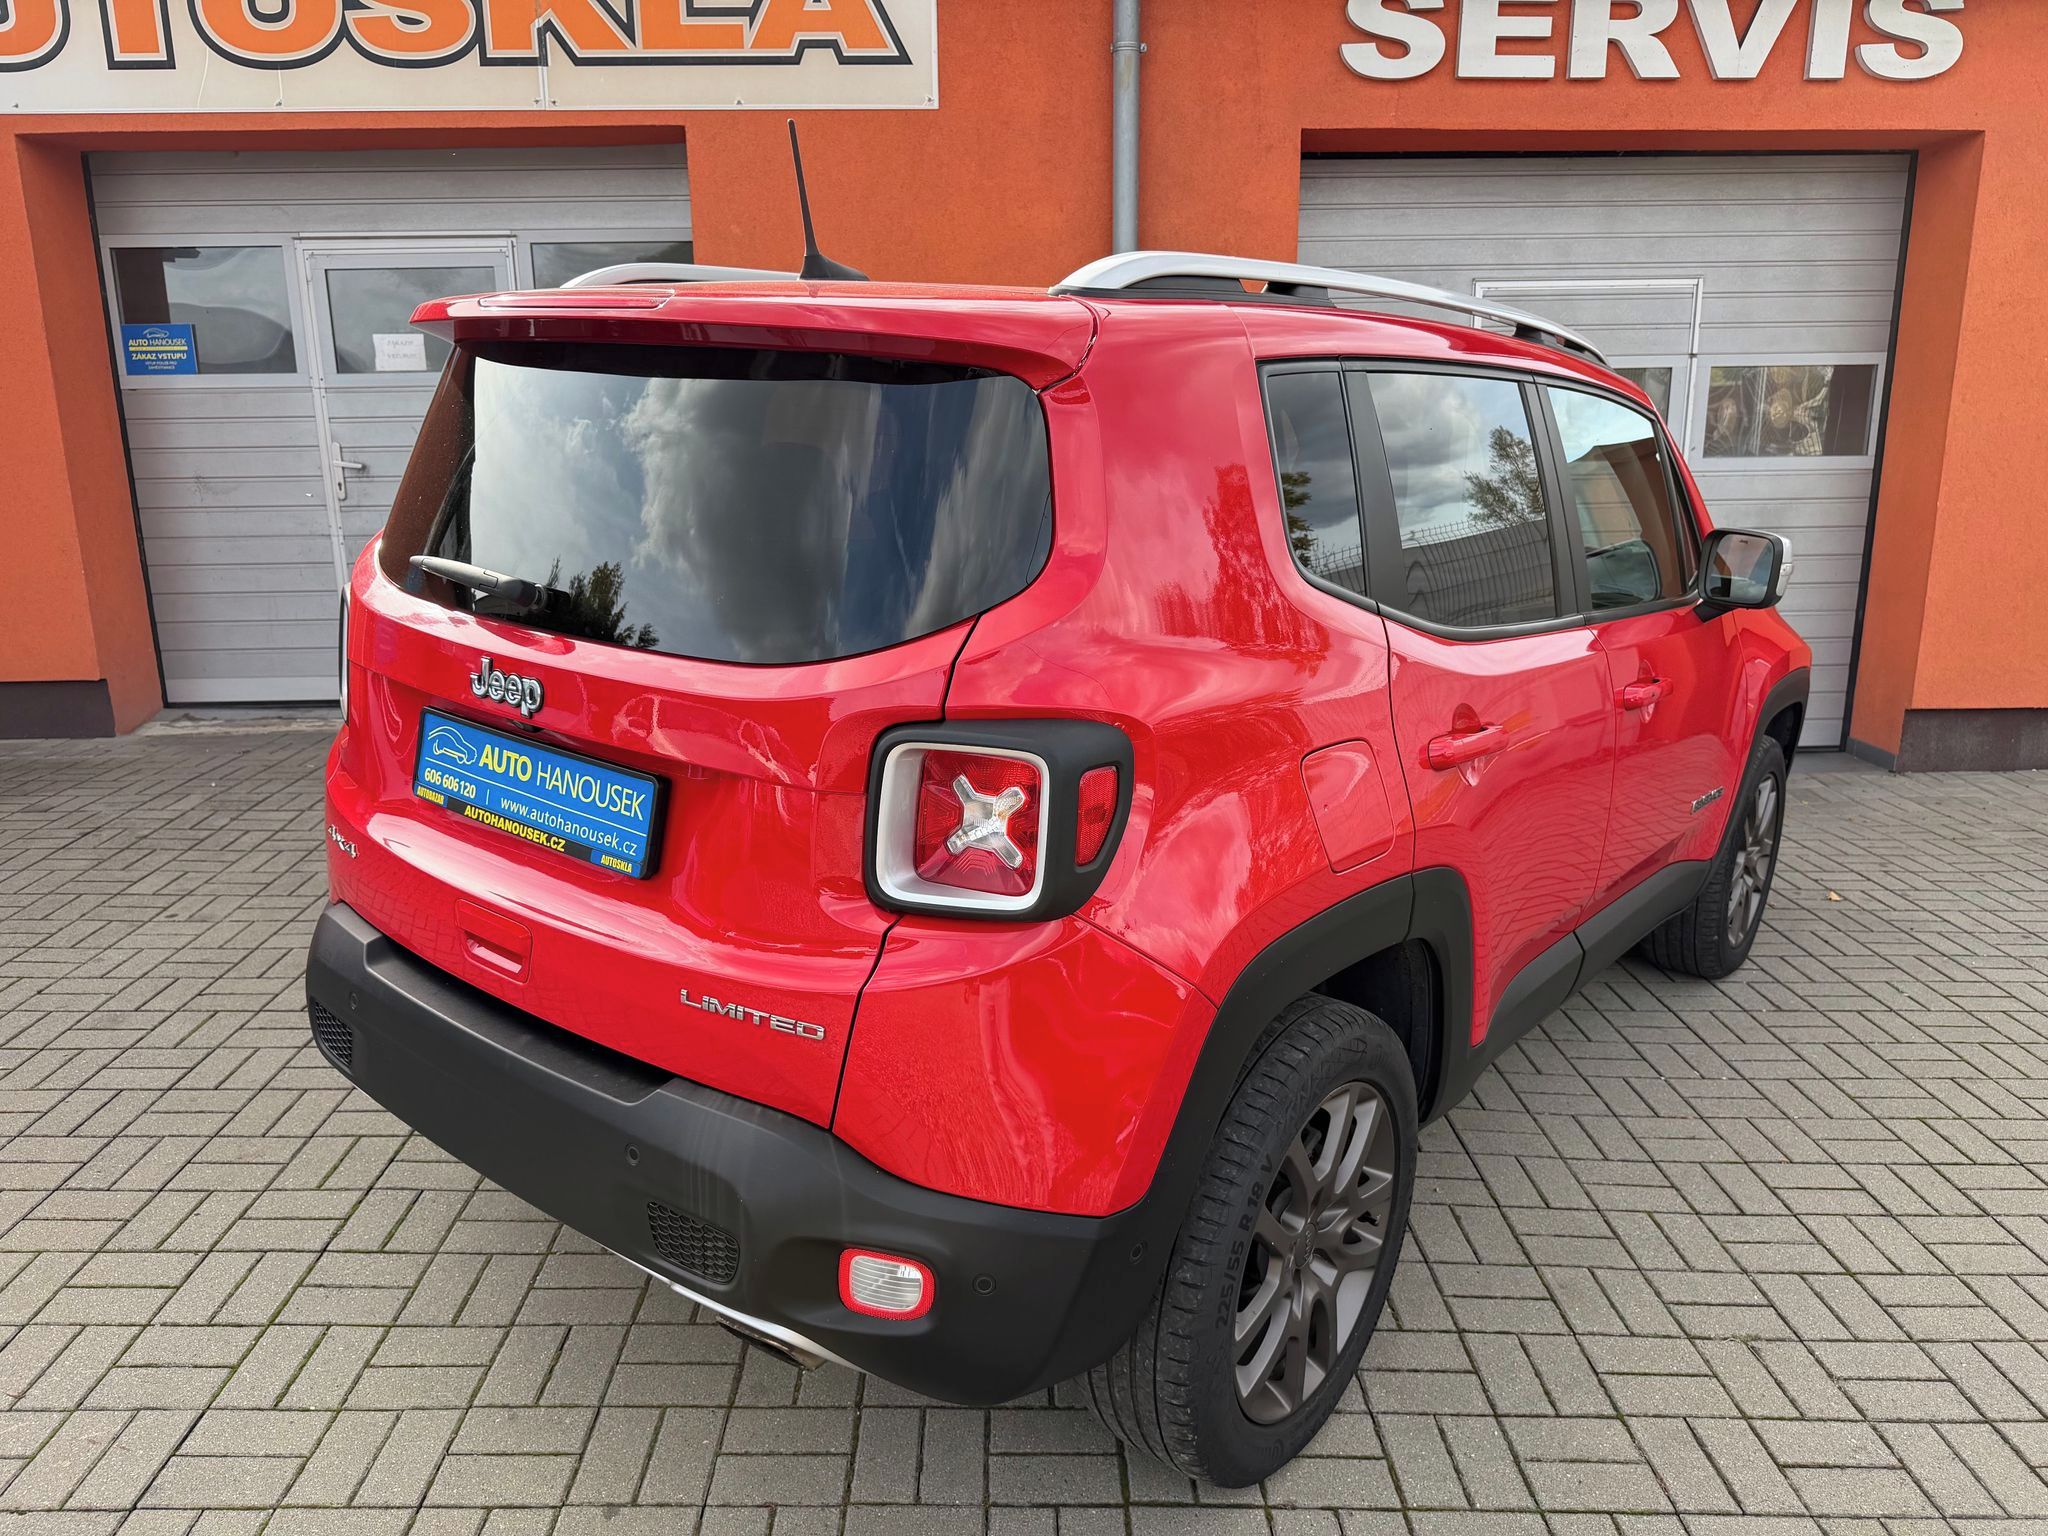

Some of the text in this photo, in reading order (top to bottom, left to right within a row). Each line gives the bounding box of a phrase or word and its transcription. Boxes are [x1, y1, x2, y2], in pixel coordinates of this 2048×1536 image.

[1340, 0, 1964, 80] SERVIS
[129, 338, 148, 346] AUTO
[470, 656, 544, 718] Jeep
[424, 768, 476, 799] 606 606 120
[479, 745, 646, 821] AUTO HANOUSEK
[464, 805, 566, 852] AUTOHANOUSEK.CZ
[501, 797, 638, 856] www.autohanousek.cz
[600, 854, 633, 873] AUTOSKLA
[680, 988, 825, 1041] LIMITED
[1215, 1240, 1245, 1329] 225/55
[1238, 1213, 1254, 1232] R
[1247, 1181, 1264, 1208] 18
